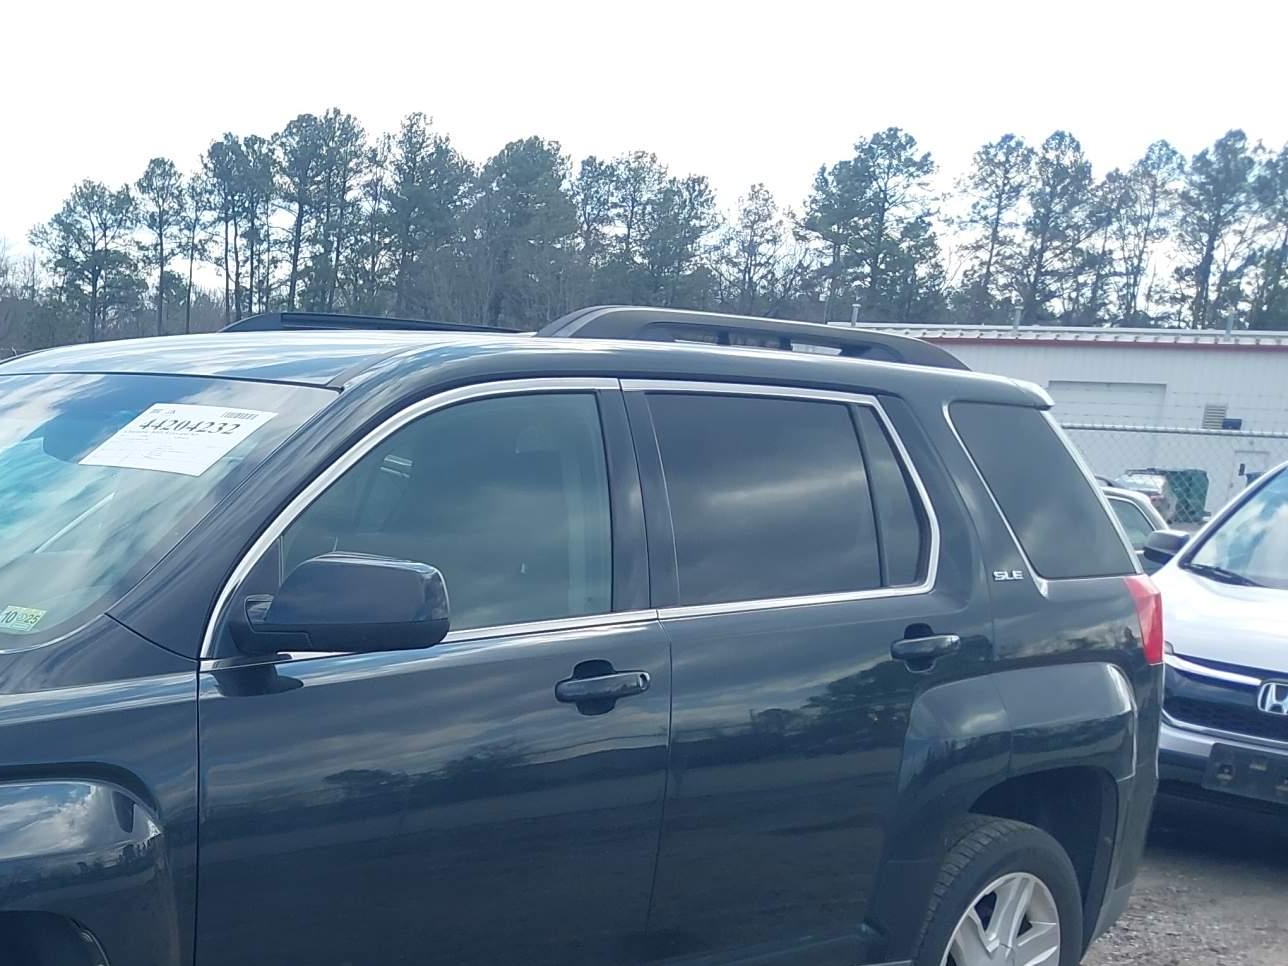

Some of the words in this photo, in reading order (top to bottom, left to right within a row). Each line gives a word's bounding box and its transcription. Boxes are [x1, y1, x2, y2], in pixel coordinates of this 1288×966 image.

[139, 418, 241, 435] 44204232
[993, 569, 1024, 581] SLE
[1, 610, 18, 624] 10
[23, 614, 41, 625] 25
